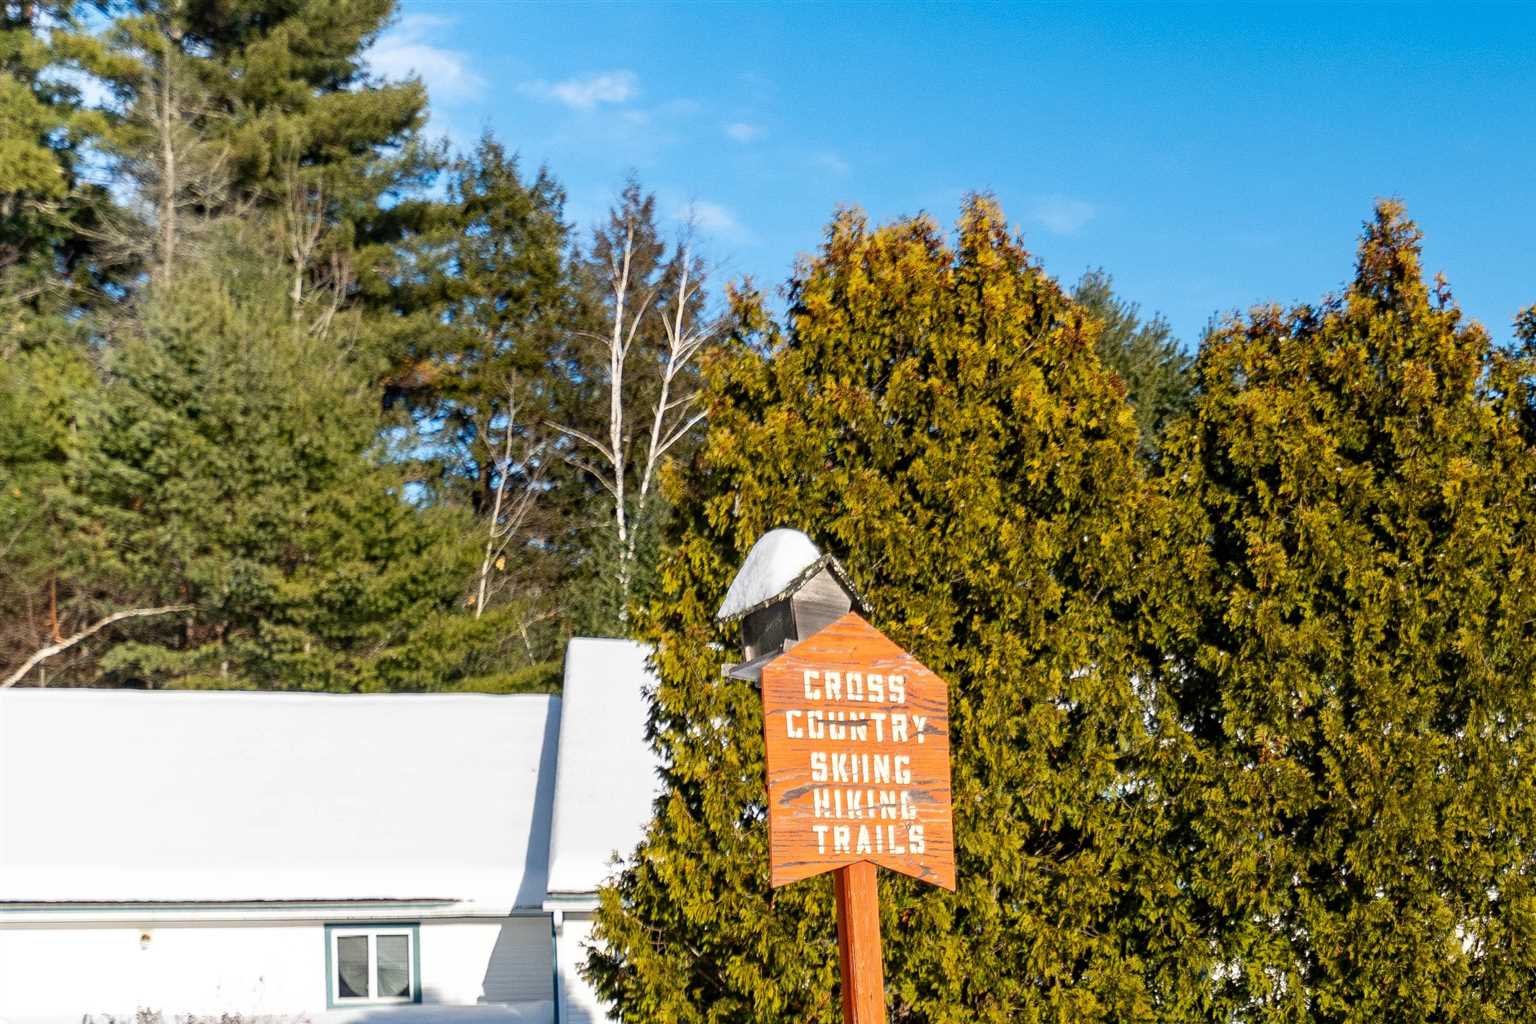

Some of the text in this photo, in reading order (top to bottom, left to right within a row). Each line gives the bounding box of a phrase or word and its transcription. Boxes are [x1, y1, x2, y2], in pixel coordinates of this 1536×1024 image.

[803, 671, 905, 703] CROSS
[785, 711, 928, 743] COUNTRY
[810, 752, 912, 784] SKIING
[813, 789, 917, 820] HIKING
[812, 824, 926, 855] TRAILS
